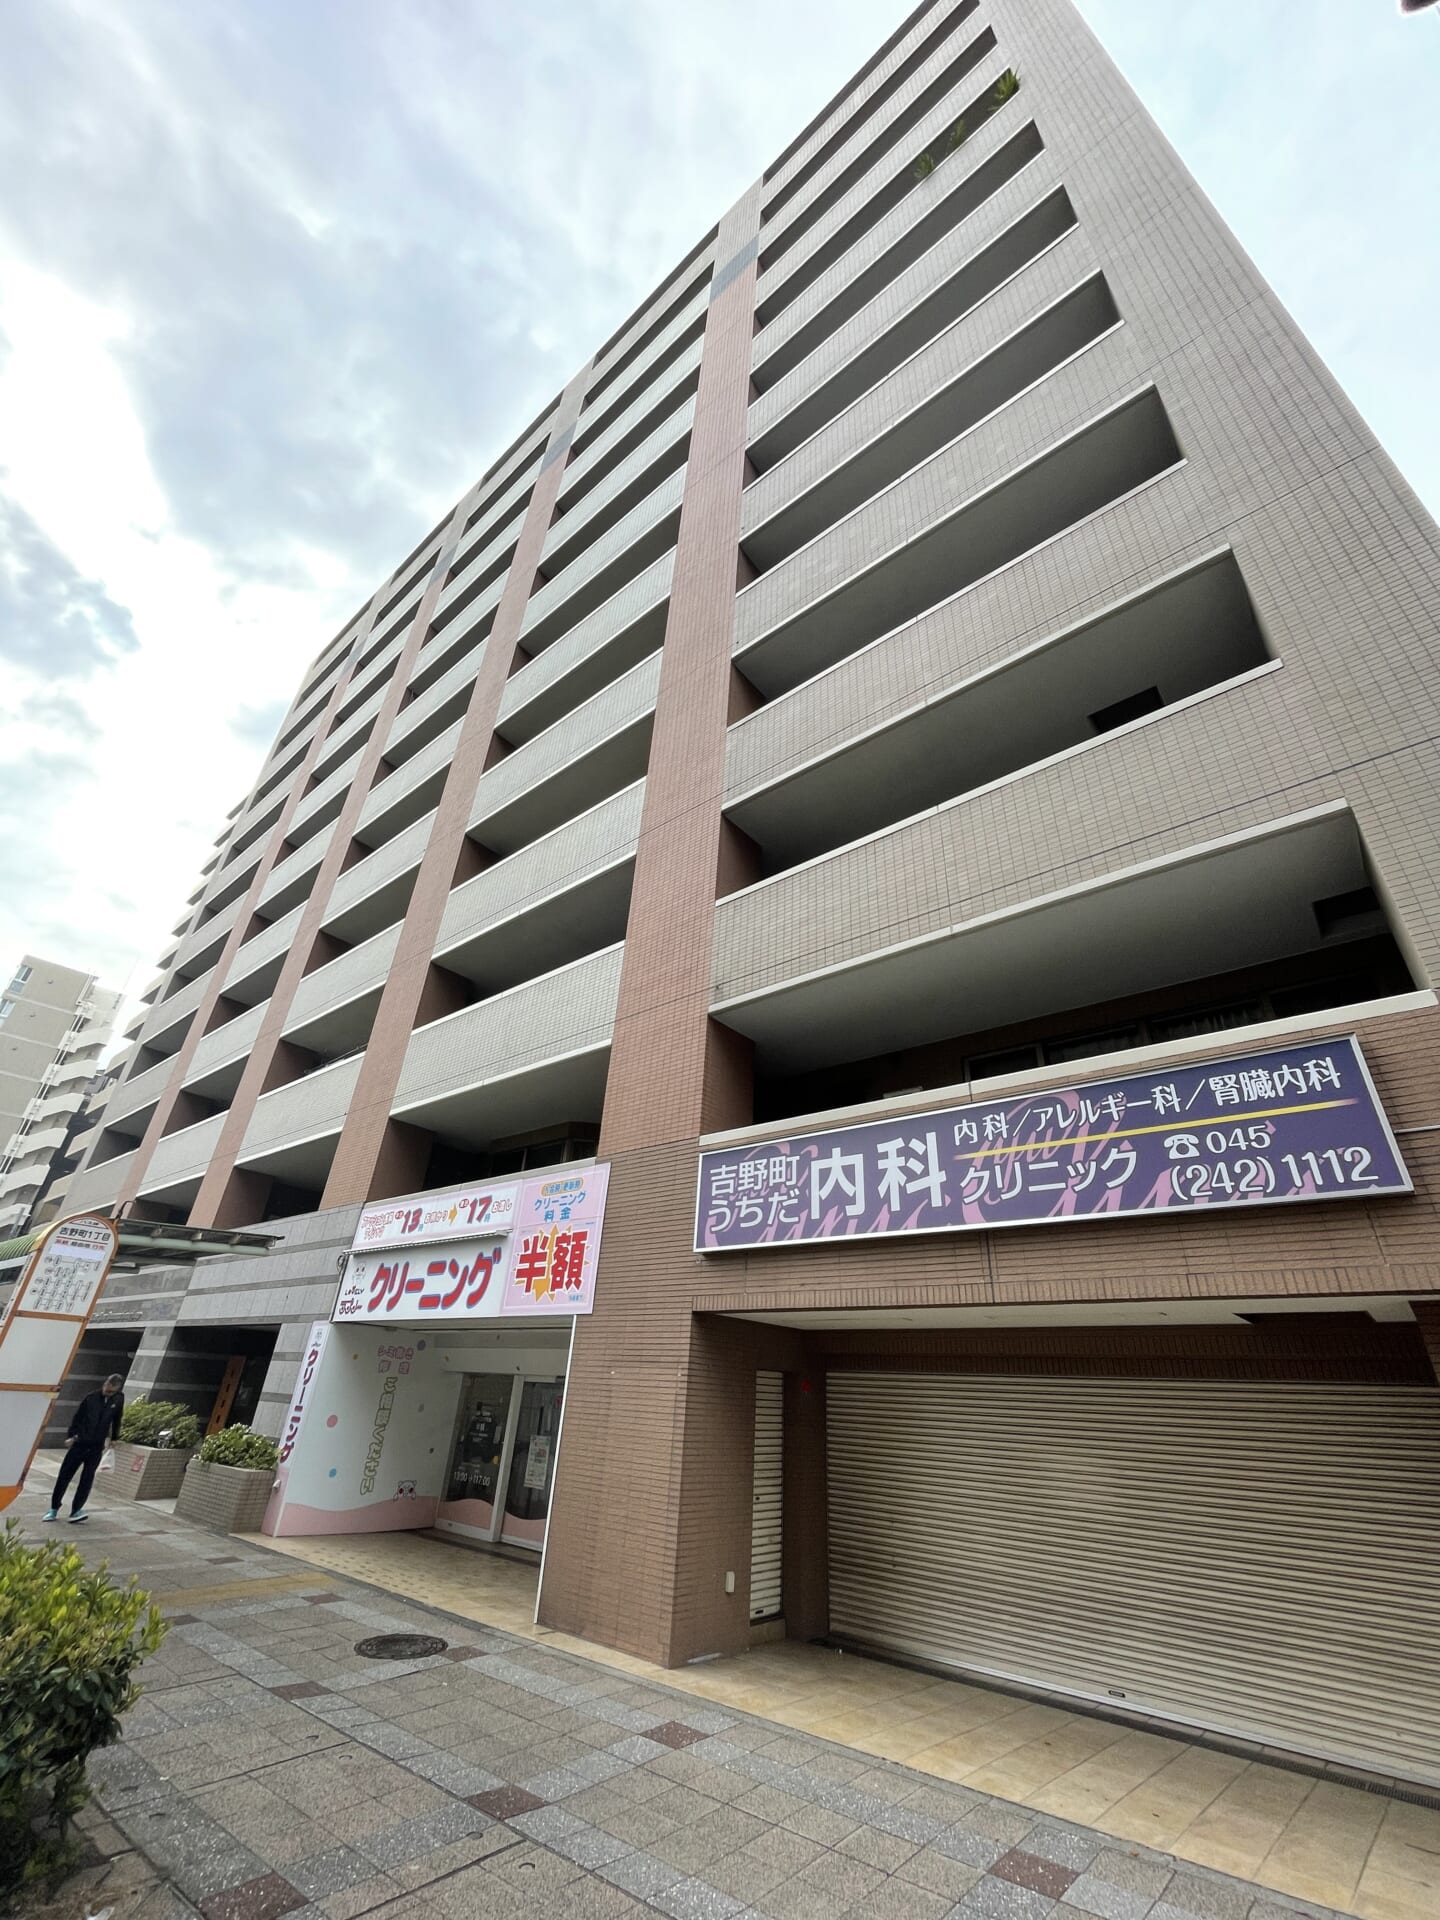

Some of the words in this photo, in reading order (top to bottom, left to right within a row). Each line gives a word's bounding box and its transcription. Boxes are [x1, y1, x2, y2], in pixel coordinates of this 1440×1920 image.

[1206, 1126, 1272, 1155] 045
[709, 1153, 800, 1198] 吉野町
[810, 1131, 946, 1220] 内科
[960, 1150, 1138, 1203] クリニック
[534, 1190, 586, 1211] クリーニング
[544, 1206, 571, 1222] 料金
[708, 1190, 800, 1232] うちだ
[59, 1226, 111, 1242] 吉野町1丁目
[367, 1247, 502, 1312] クリーニング
[515, 1230, 588, 1293] 半額
[279, 1348, 319, 1464] クリーニング
